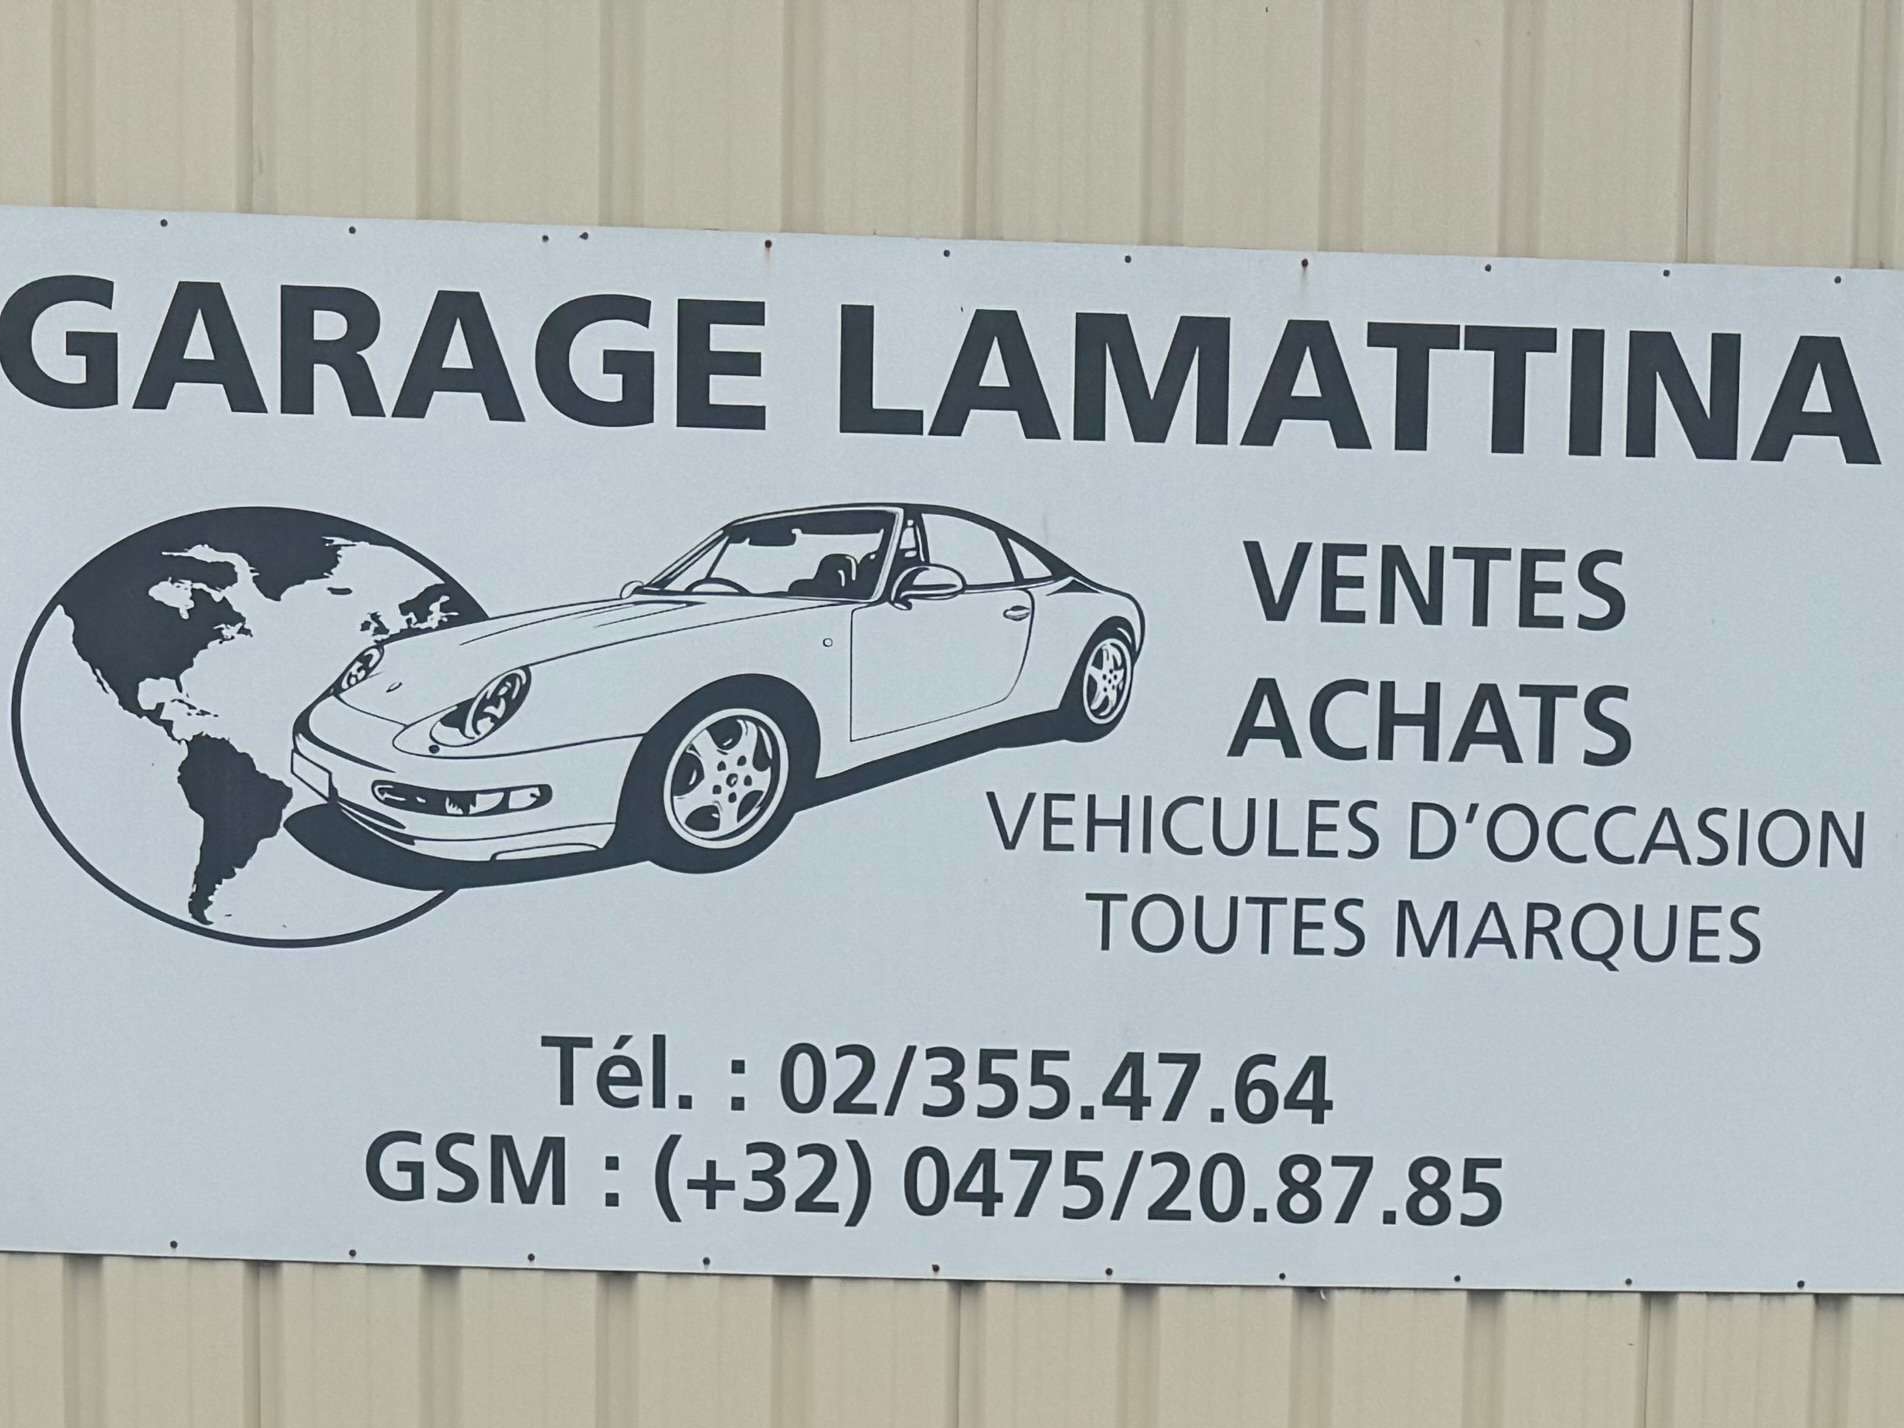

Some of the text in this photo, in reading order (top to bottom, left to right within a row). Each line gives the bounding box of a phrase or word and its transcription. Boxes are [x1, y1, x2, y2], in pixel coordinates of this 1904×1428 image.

[839, 303, 1882, 465] LAMATTINA
[1242, 540, 1626, 632] VENTES
[1226, 677, 1632, 767] ACHATS
[985, 791, 1380, 860] VEHICULES
[1085, 892, 1761, 972] TOUTES MARQUES
[540, 1033, 693, 1110] Tél.
[780, 1042, 1334, 1125] 02/355.47.64
[365, 1130, 566, 1206] GSM
[654, 1134, 872, 1228] (+32)
[903, 1145, 1503, 1228] 0475/20.87.85
